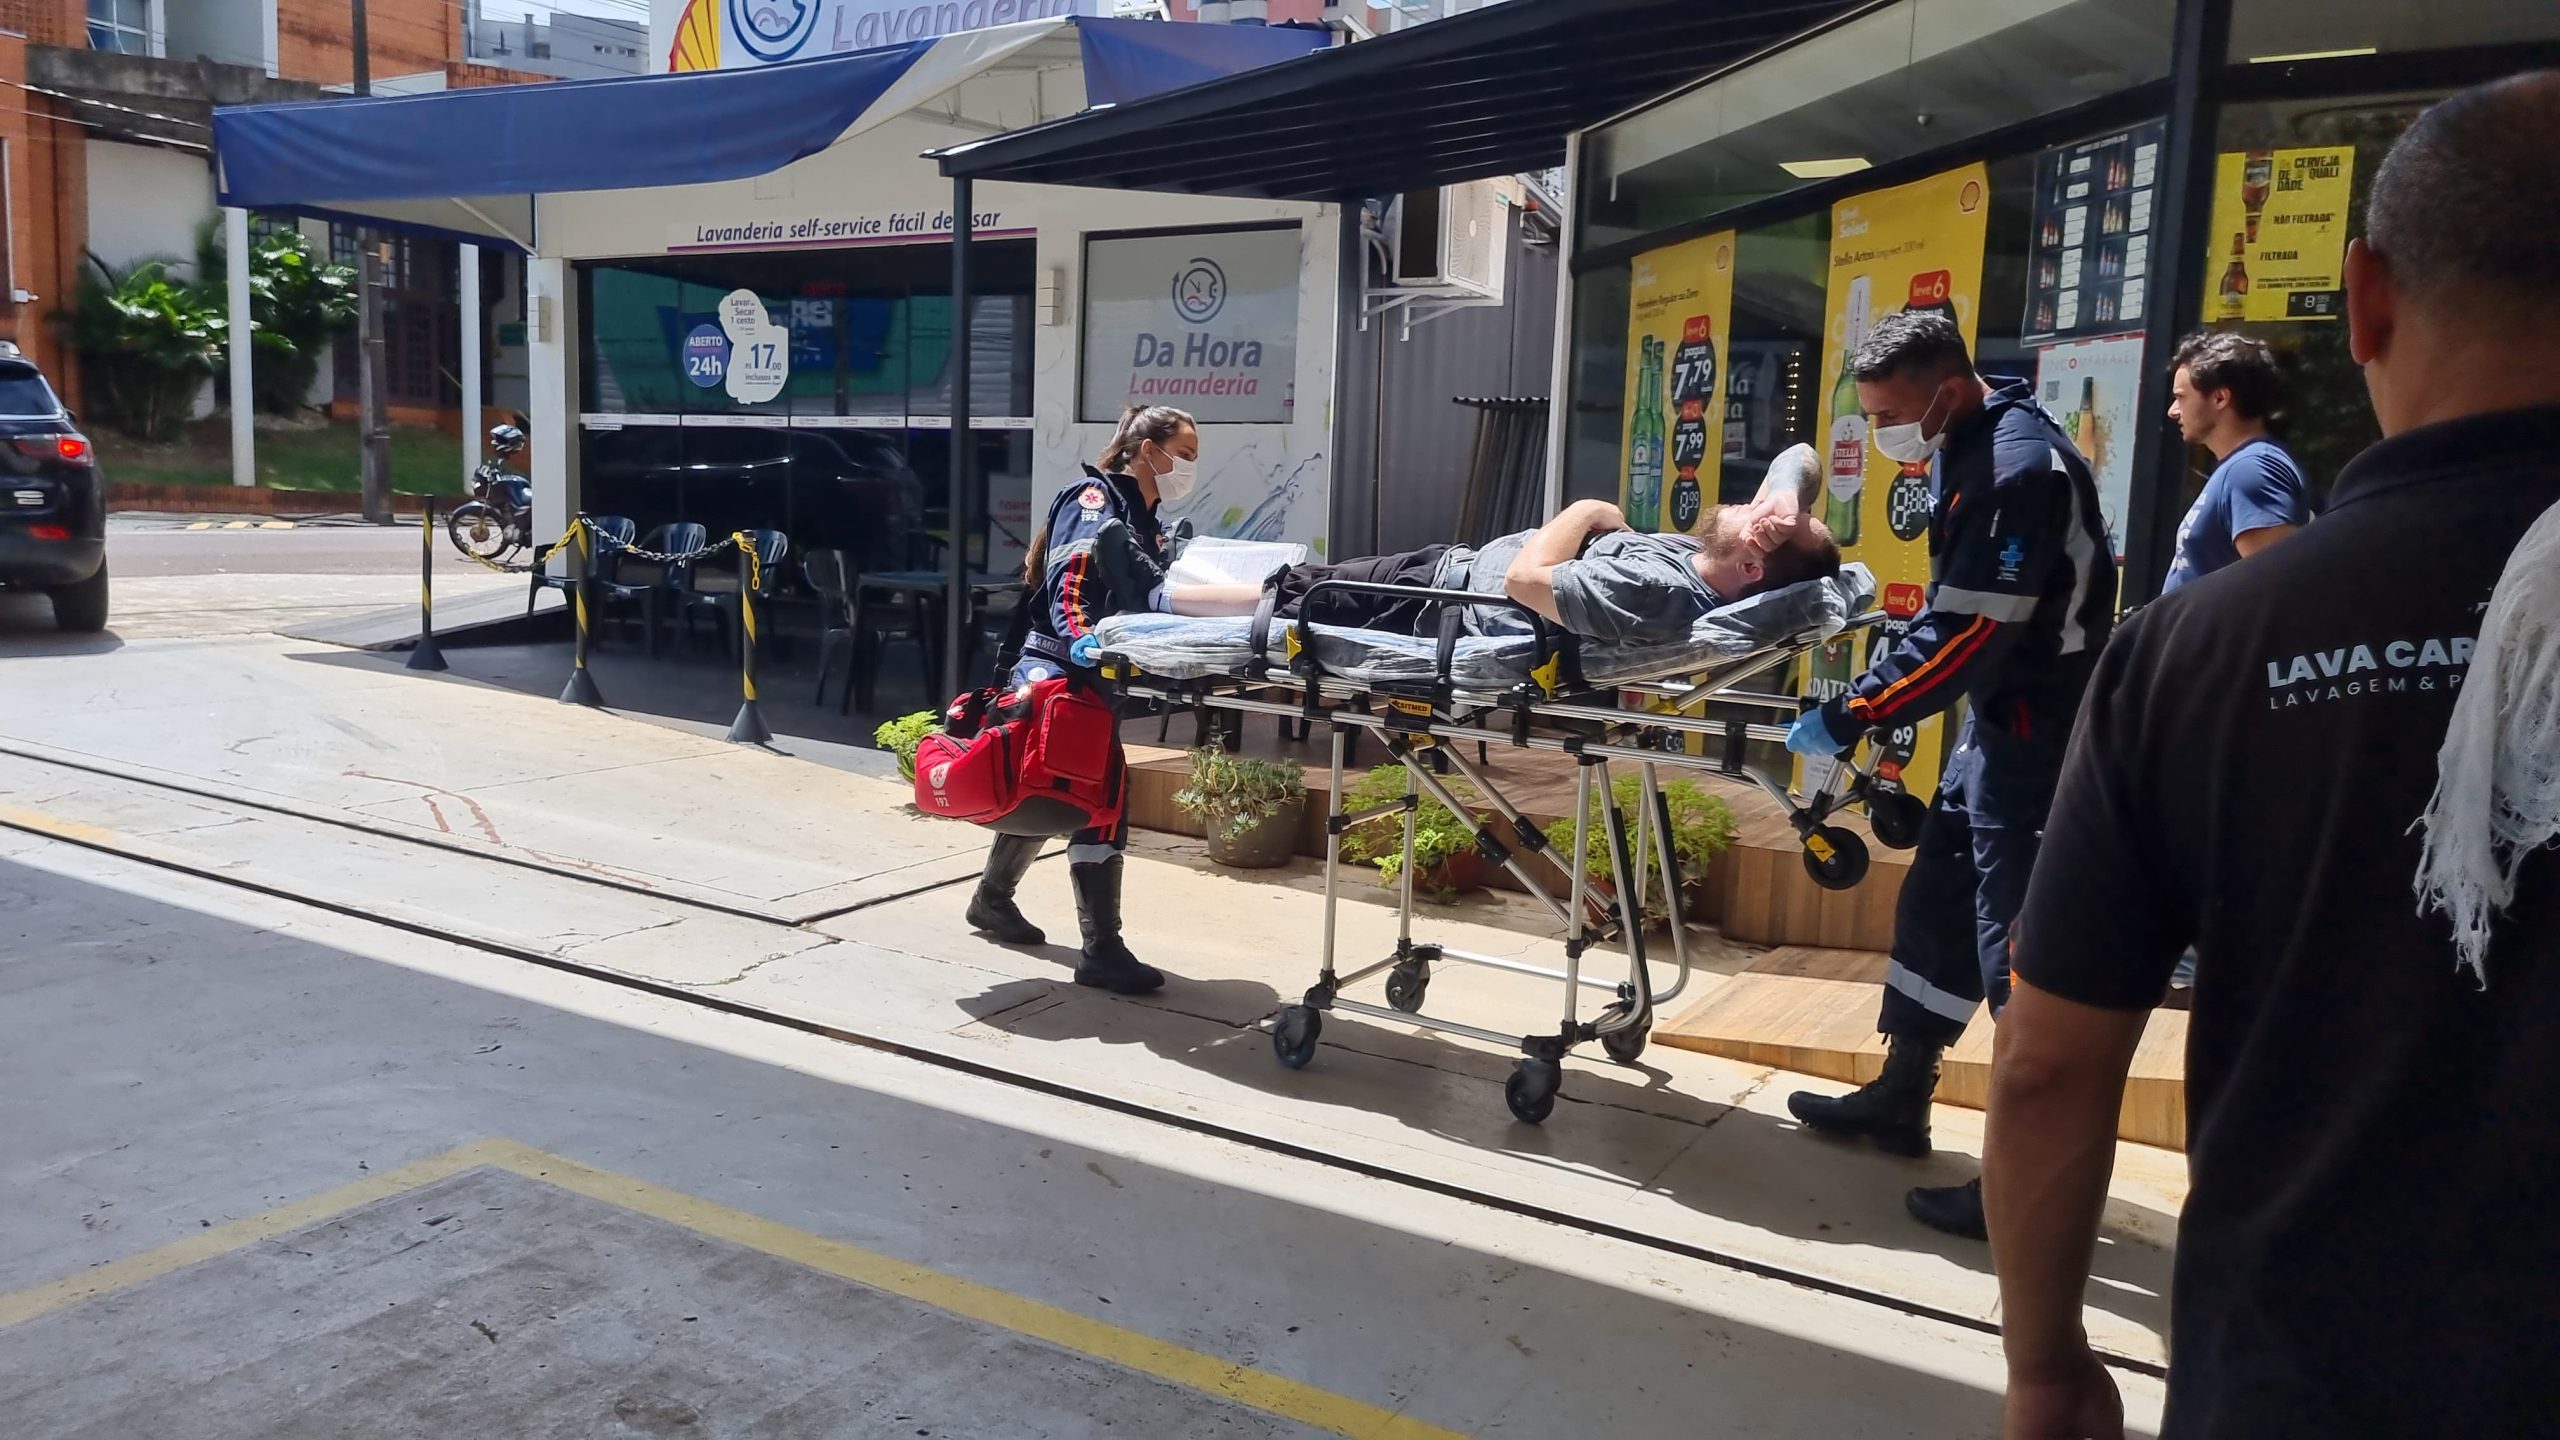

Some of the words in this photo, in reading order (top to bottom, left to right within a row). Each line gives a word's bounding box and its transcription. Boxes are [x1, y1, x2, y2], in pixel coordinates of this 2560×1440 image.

[2294, 155, 2340, 168] CERVEJA
[697, 221, 783, 243] Lavanderia
[790, 216, 881, 239] self-service
[888, 211, 926, 233] fácil
[932, 210, 952, 230] de
[971, 211, 1001, 228] sar
[2259, 250, 2299, 261] FILTRADA
[1932, 273, 1945, 300] 6
[730, 298, 750, 307] Lavar
[735, 308, 756, 317] Secar
[736, 316, 756, 325] cesto
[1698, 318, 1708, 338] 6
[688, 335, 723, 347] ABERTO
[1132, 333, 1175, 368] Da
[1184, 332, 1263, 368] Hora
[690, 355, 723, 377] 24h
[1129, 371, 1259, 396] Lavanderia
[1673, 358, 1713, 401] 7,79
[1674, 431, 1704, 462] 7,99
[1080, 514, 1099, 522] 192
[1906, 588, 1918, 613] 6
[1884, 619, 1910, 635] pagu
[1028, 635, 1059, 652] SAMU
[2267, 643, 2379, 689] LAVA
[2385, 637, 2478, 668] CAR
[2269, 676, 2406, 710] LAVAGEM
[2419, 676, 2436, 690] &
[935, 796, 950, 808] 192
